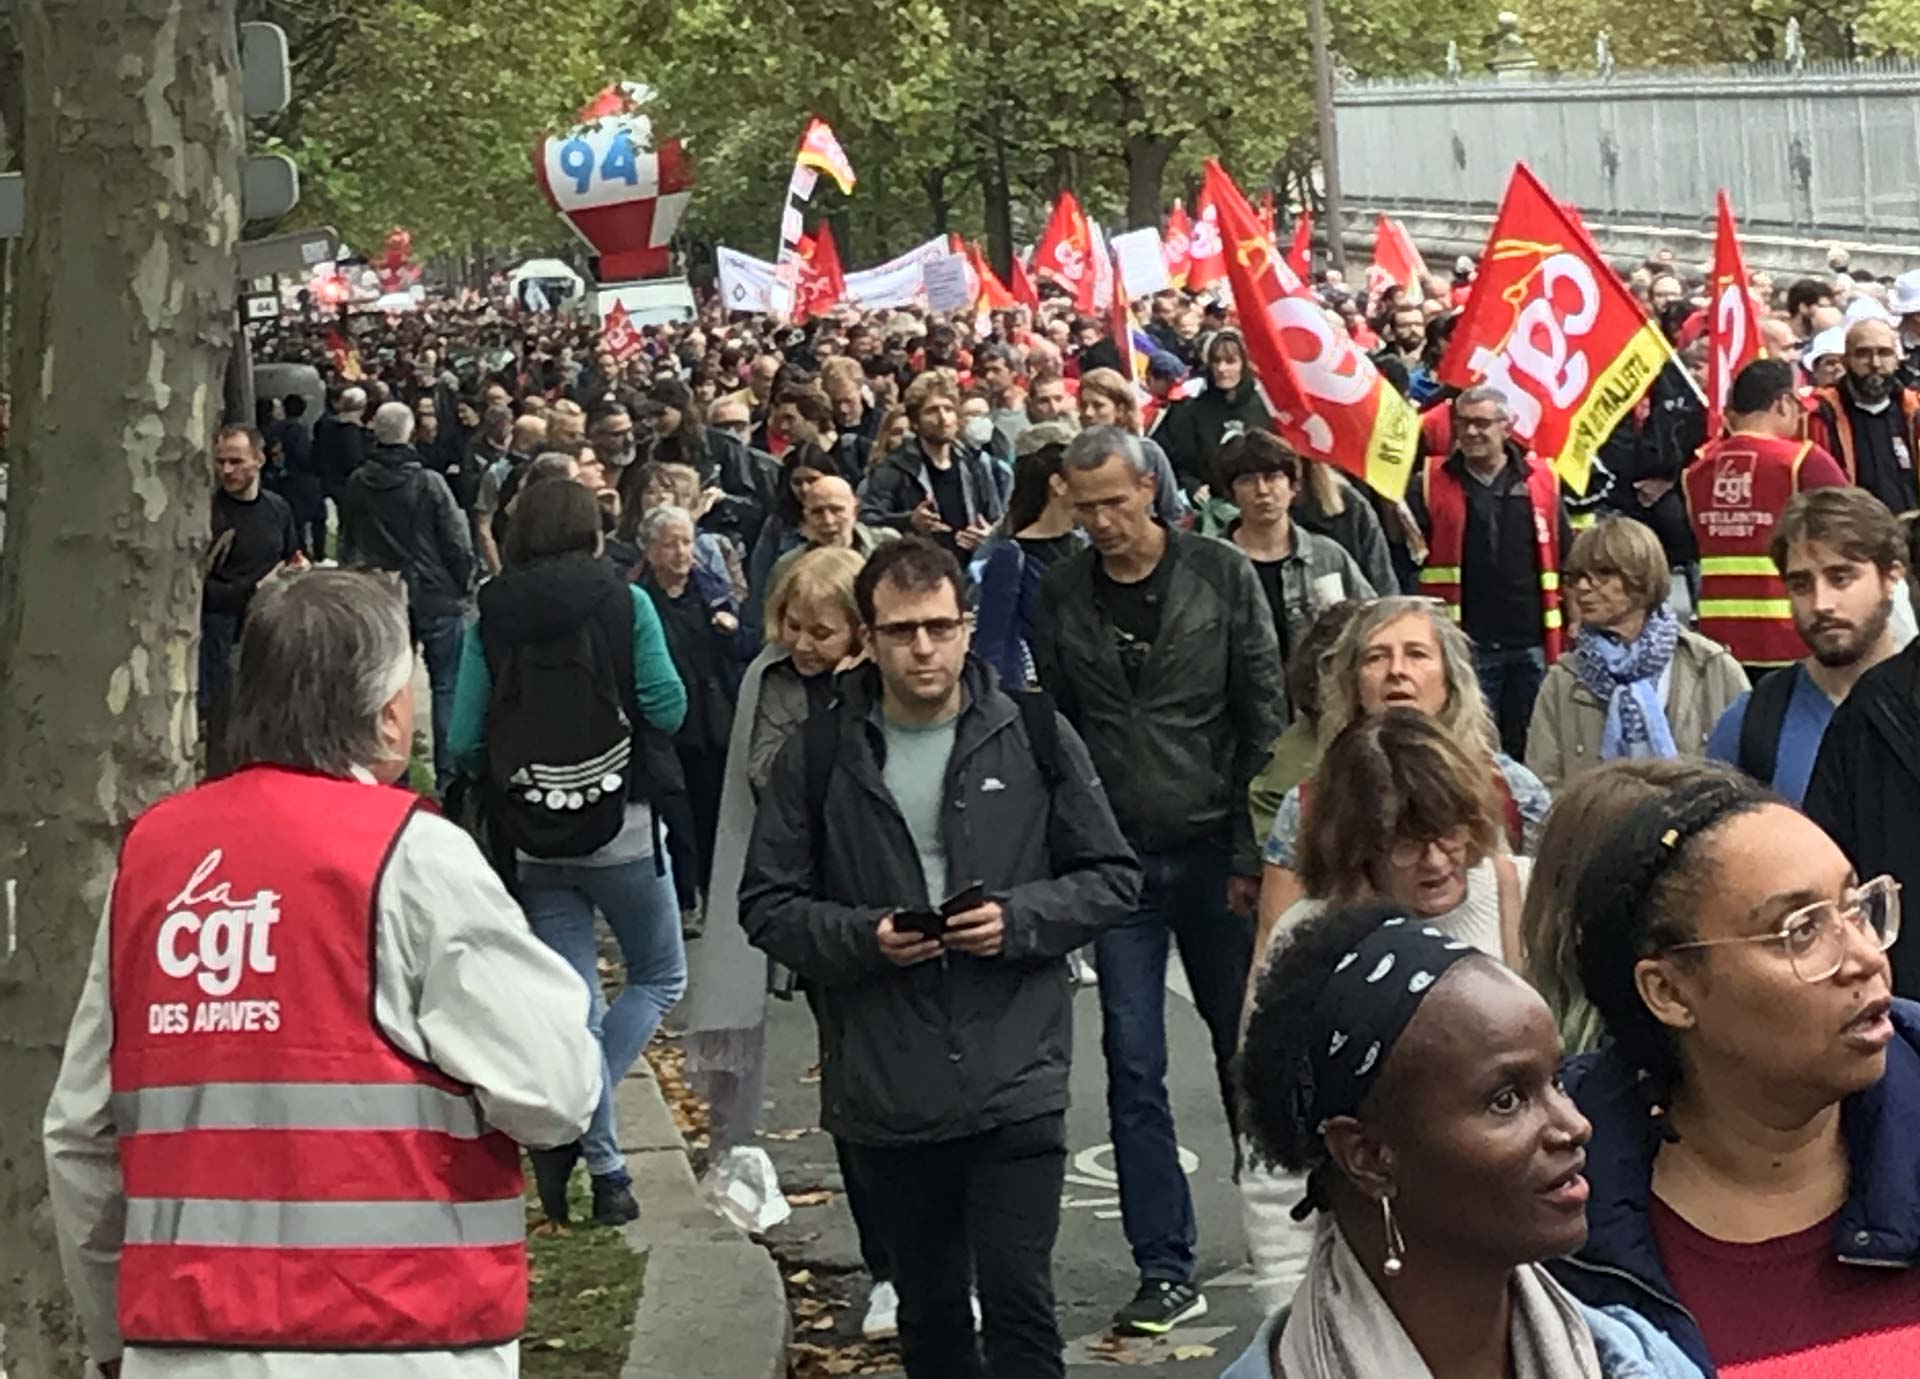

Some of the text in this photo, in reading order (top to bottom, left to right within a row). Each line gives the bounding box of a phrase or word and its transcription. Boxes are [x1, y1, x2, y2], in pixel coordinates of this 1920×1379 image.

[560, 129, 638, 195] 94
[1713, 471, 1753, 504] cgt
[166, 848, 268, 911] la
[156, 890, 282, 996] cgt
[148, 1003, 188, 1035] DES
